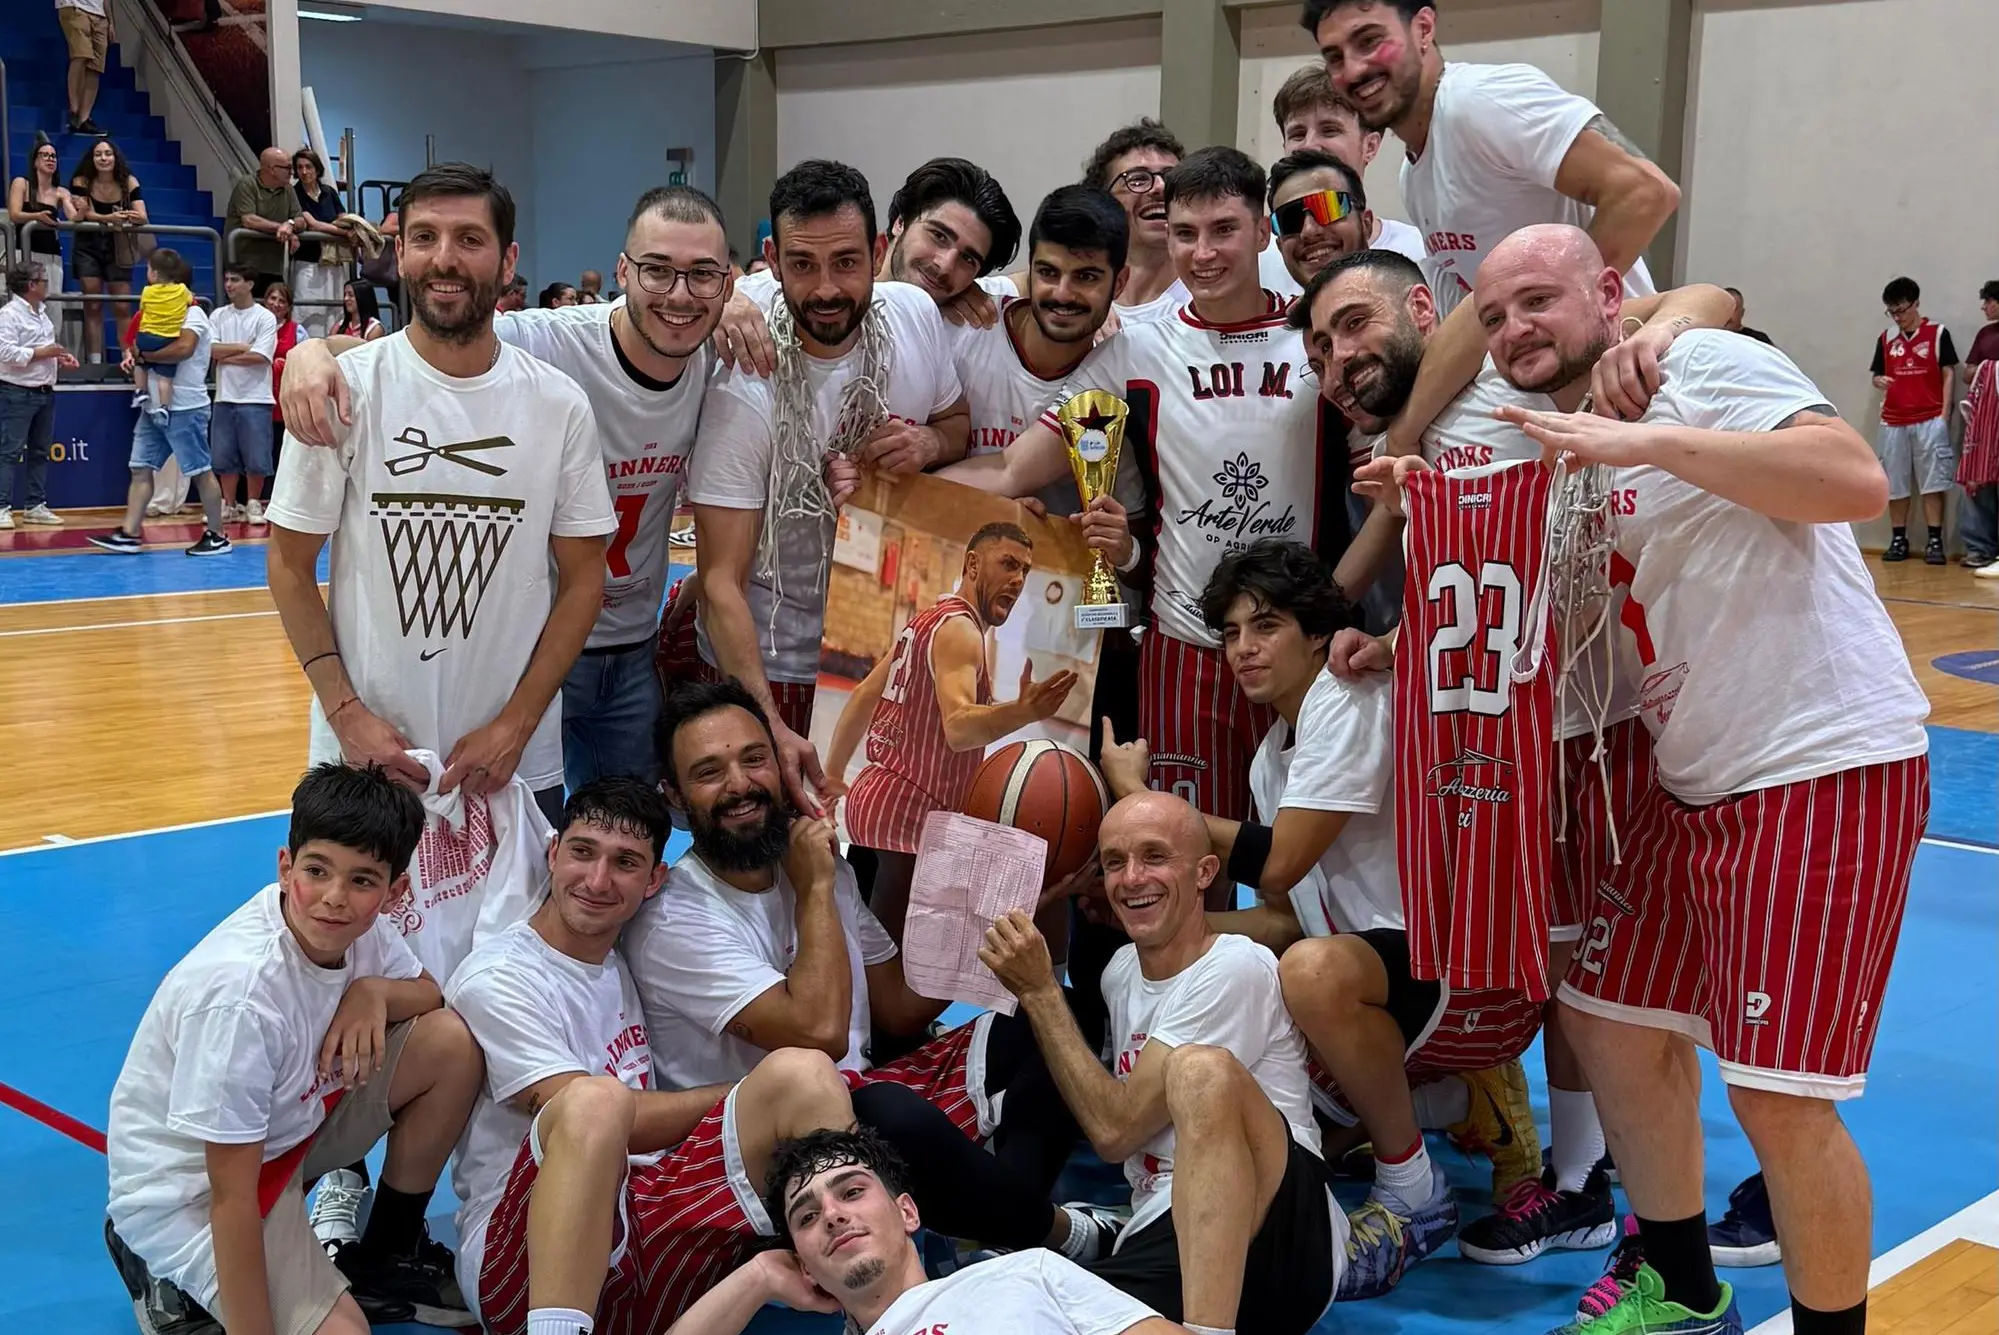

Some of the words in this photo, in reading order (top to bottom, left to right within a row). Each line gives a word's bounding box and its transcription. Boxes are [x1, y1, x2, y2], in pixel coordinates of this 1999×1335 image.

[1187, 362, 1245, 400] LOI
[1259, 361, 1293, 399] M.
[50, 437, 89, 462] o.it
[608, 454, 686, 480] INNERS
[1428, 558, 1523, 717] 23
